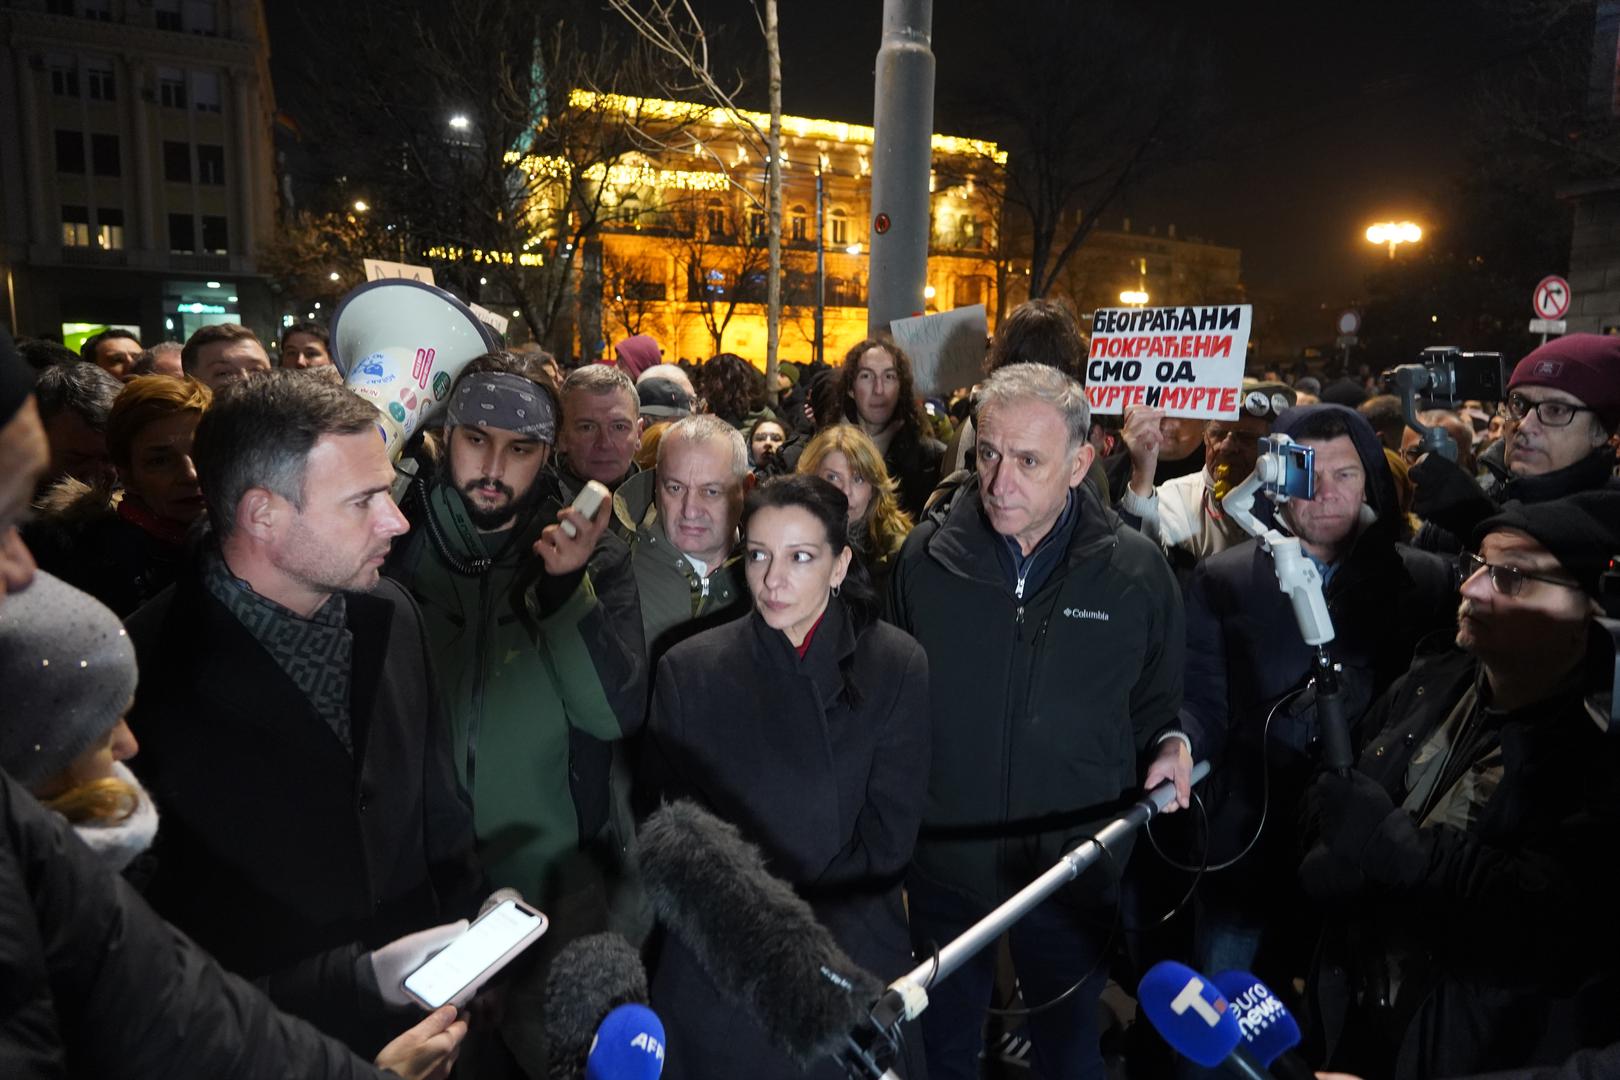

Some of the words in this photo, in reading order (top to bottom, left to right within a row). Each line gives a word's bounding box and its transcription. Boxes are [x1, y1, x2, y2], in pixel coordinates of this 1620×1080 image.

[1088, 360, 1142, 382] СМО
[1155, 361, 1196, 383] ОД
[1159, 386, 1239, 412] МУРТЕ
[1072, 608, 1109, 621] Columbia
